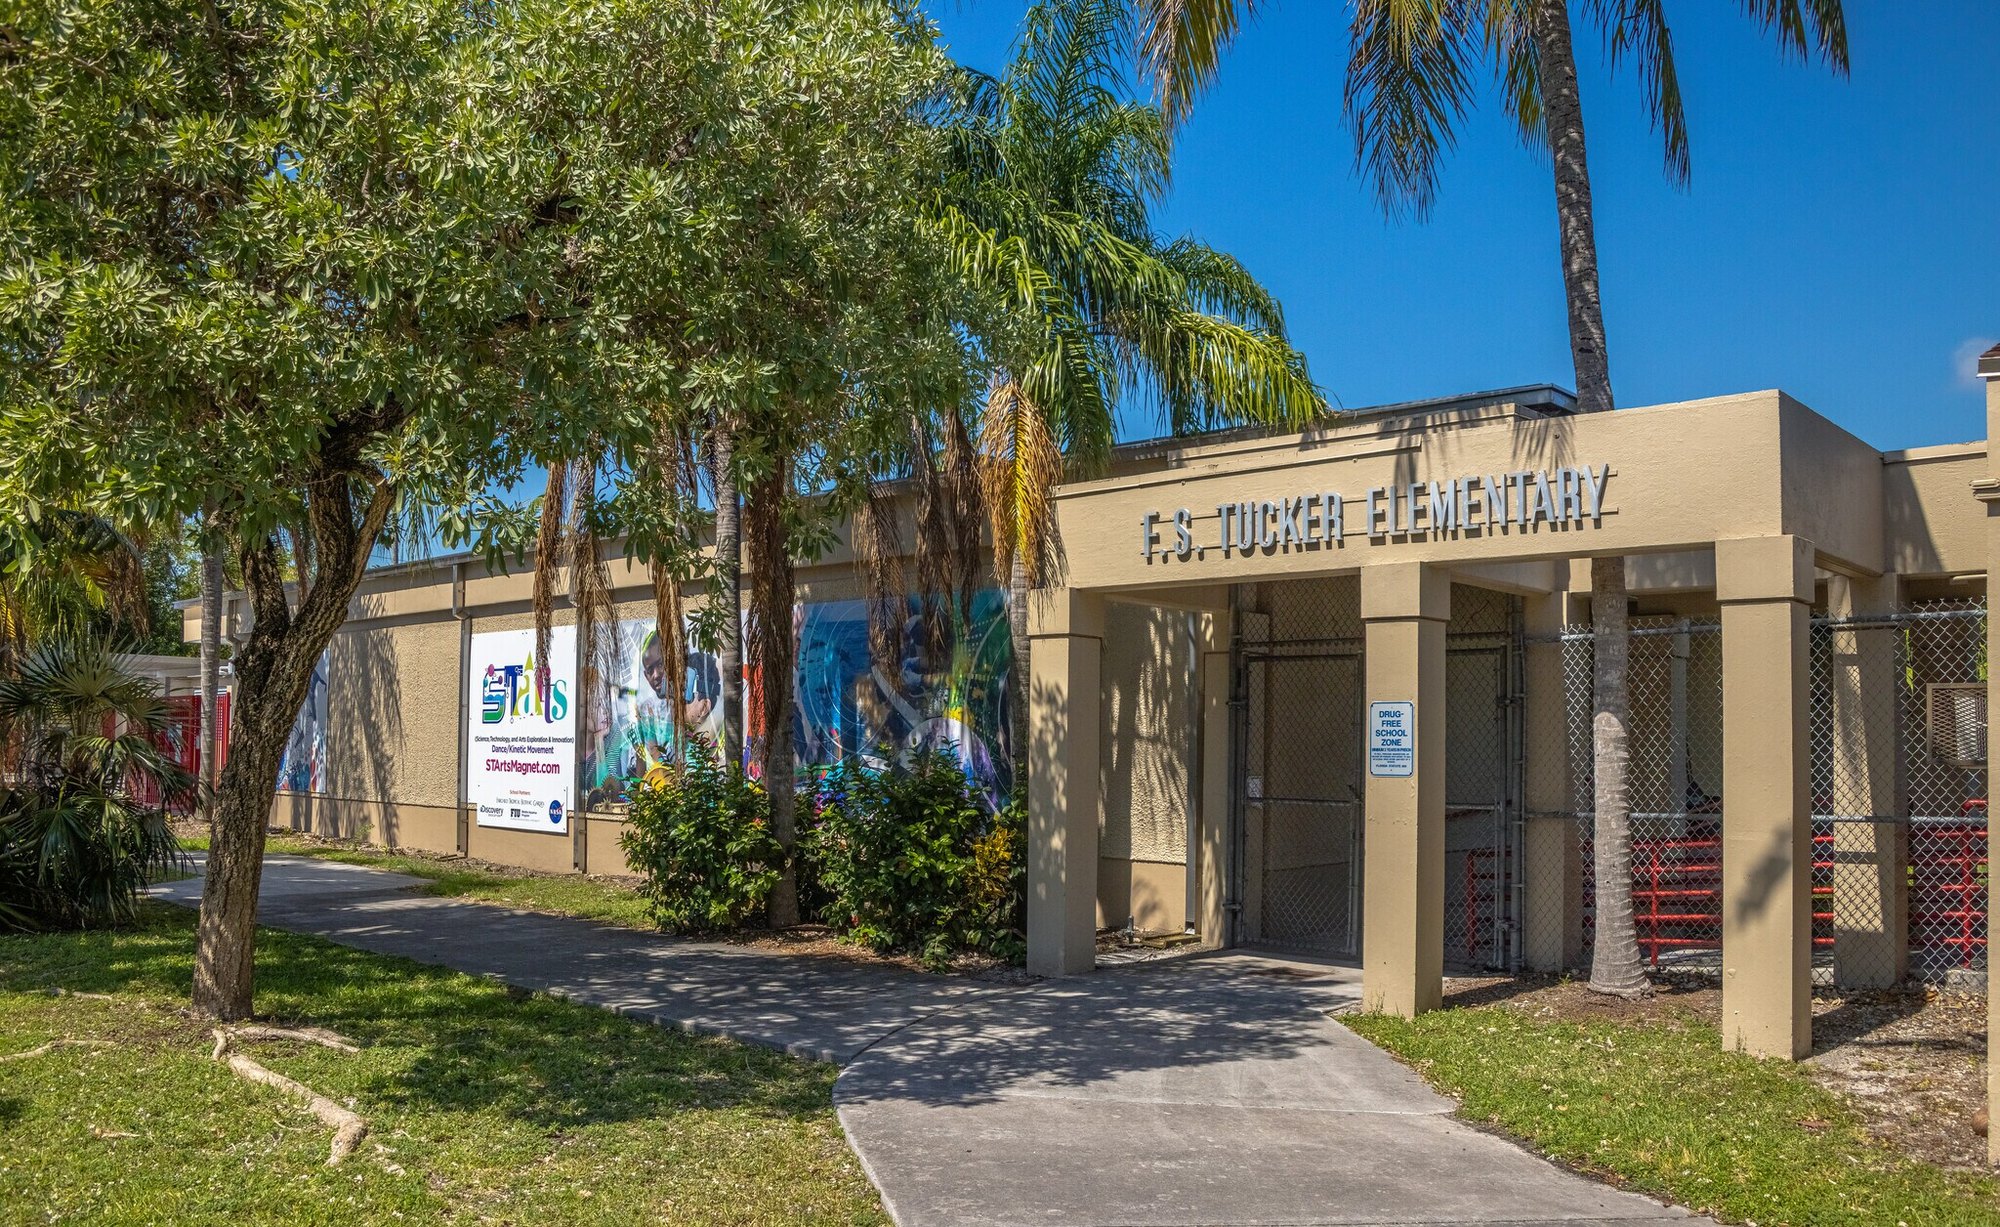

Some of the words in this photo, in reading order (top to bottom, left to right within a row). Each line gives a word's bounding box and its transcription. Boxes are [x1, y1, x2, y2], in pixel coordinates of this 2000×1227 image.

[1143, 508, 1204, 559] F.S.
[1216, 491, 1345, 550] TUCKER
[1366, 464, 1610, 538] ELEMENTARY
[527, 736, 548, 744] Exploration
[492, 745, 526, 754] Dance/Kinetic
[527, 745, 554, 754] Movement
[486, 759, 560, 775] STArtsMagnet.com
